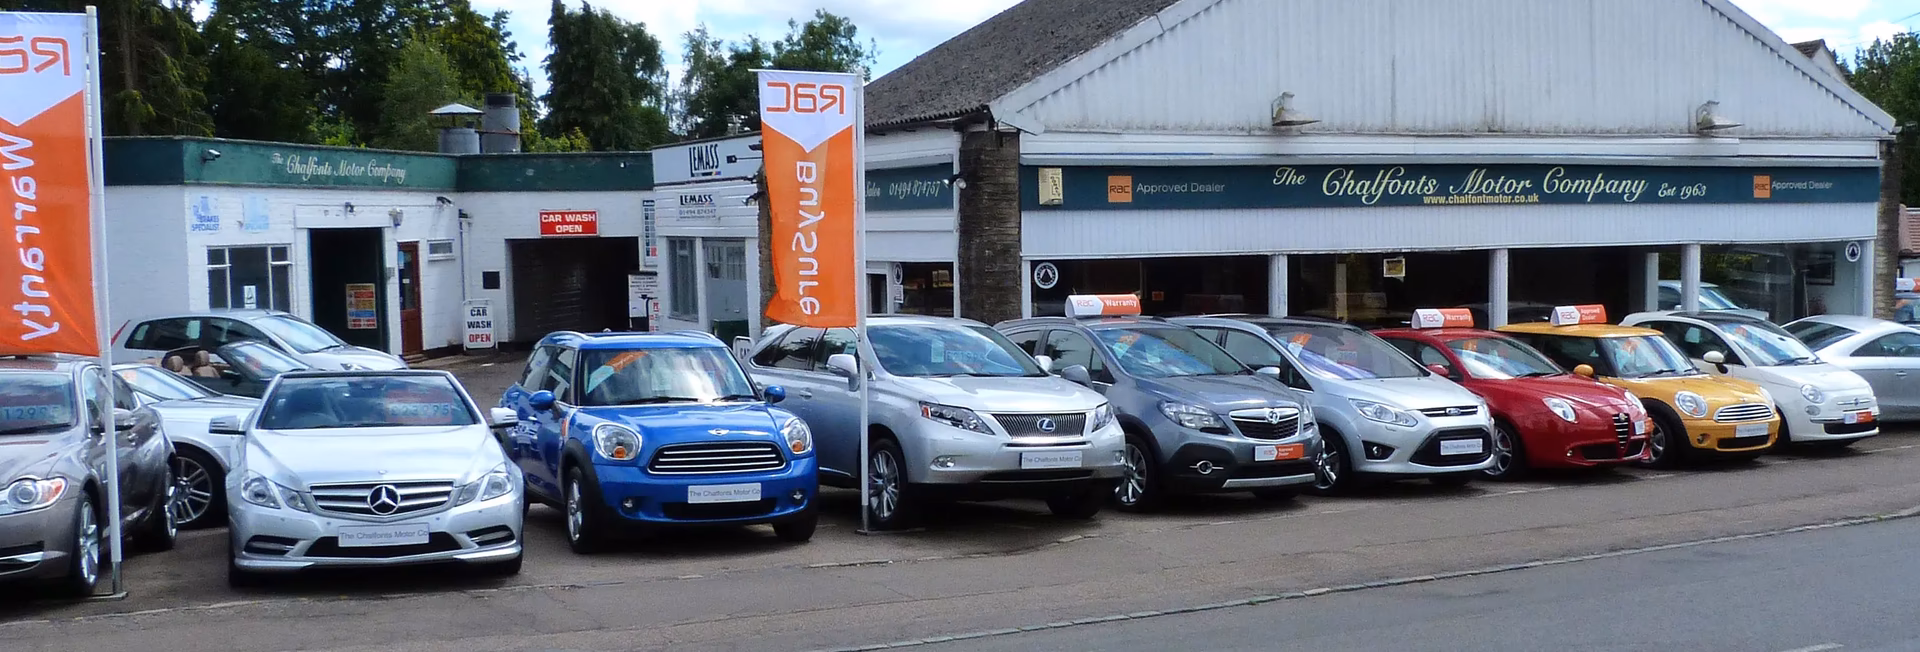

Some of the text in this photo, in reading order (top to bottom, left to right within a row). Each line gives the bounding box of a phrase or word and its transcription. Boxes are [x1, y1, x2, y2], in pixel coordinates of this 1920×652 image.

[688, 144, 720, 177] LEMASS
[272, 153, 406, 185] The Chalfonts Motor Company
[1136, 182, 1188, 195] Approved
[1190, 182, 1225, 193] Dealer
[1272, 166, 1707, 206] The Chalfonts Motor Company Est 1963
[1772, 180, 1807, 190] Approved
[1808, 180, 1833, 189] Dealer
[680, 194, 713, 206] LEMASS
[1423, 192, 1539, 205] www.chalfontmotor.co.uk
[541, 213, 596, 223] CAR WASH
[555, 224, 583, 233] OPEN
[1104, 299, 1137, 308] Warranty
[470, 308, 488, 317] CAR
[467, 320, 492, 329] WASH
[468, 333, 492, 343] OPEN
[733, 488, 750, 496] Motor
[340, 529, 429, 540] The Chalfonts Motor Co
